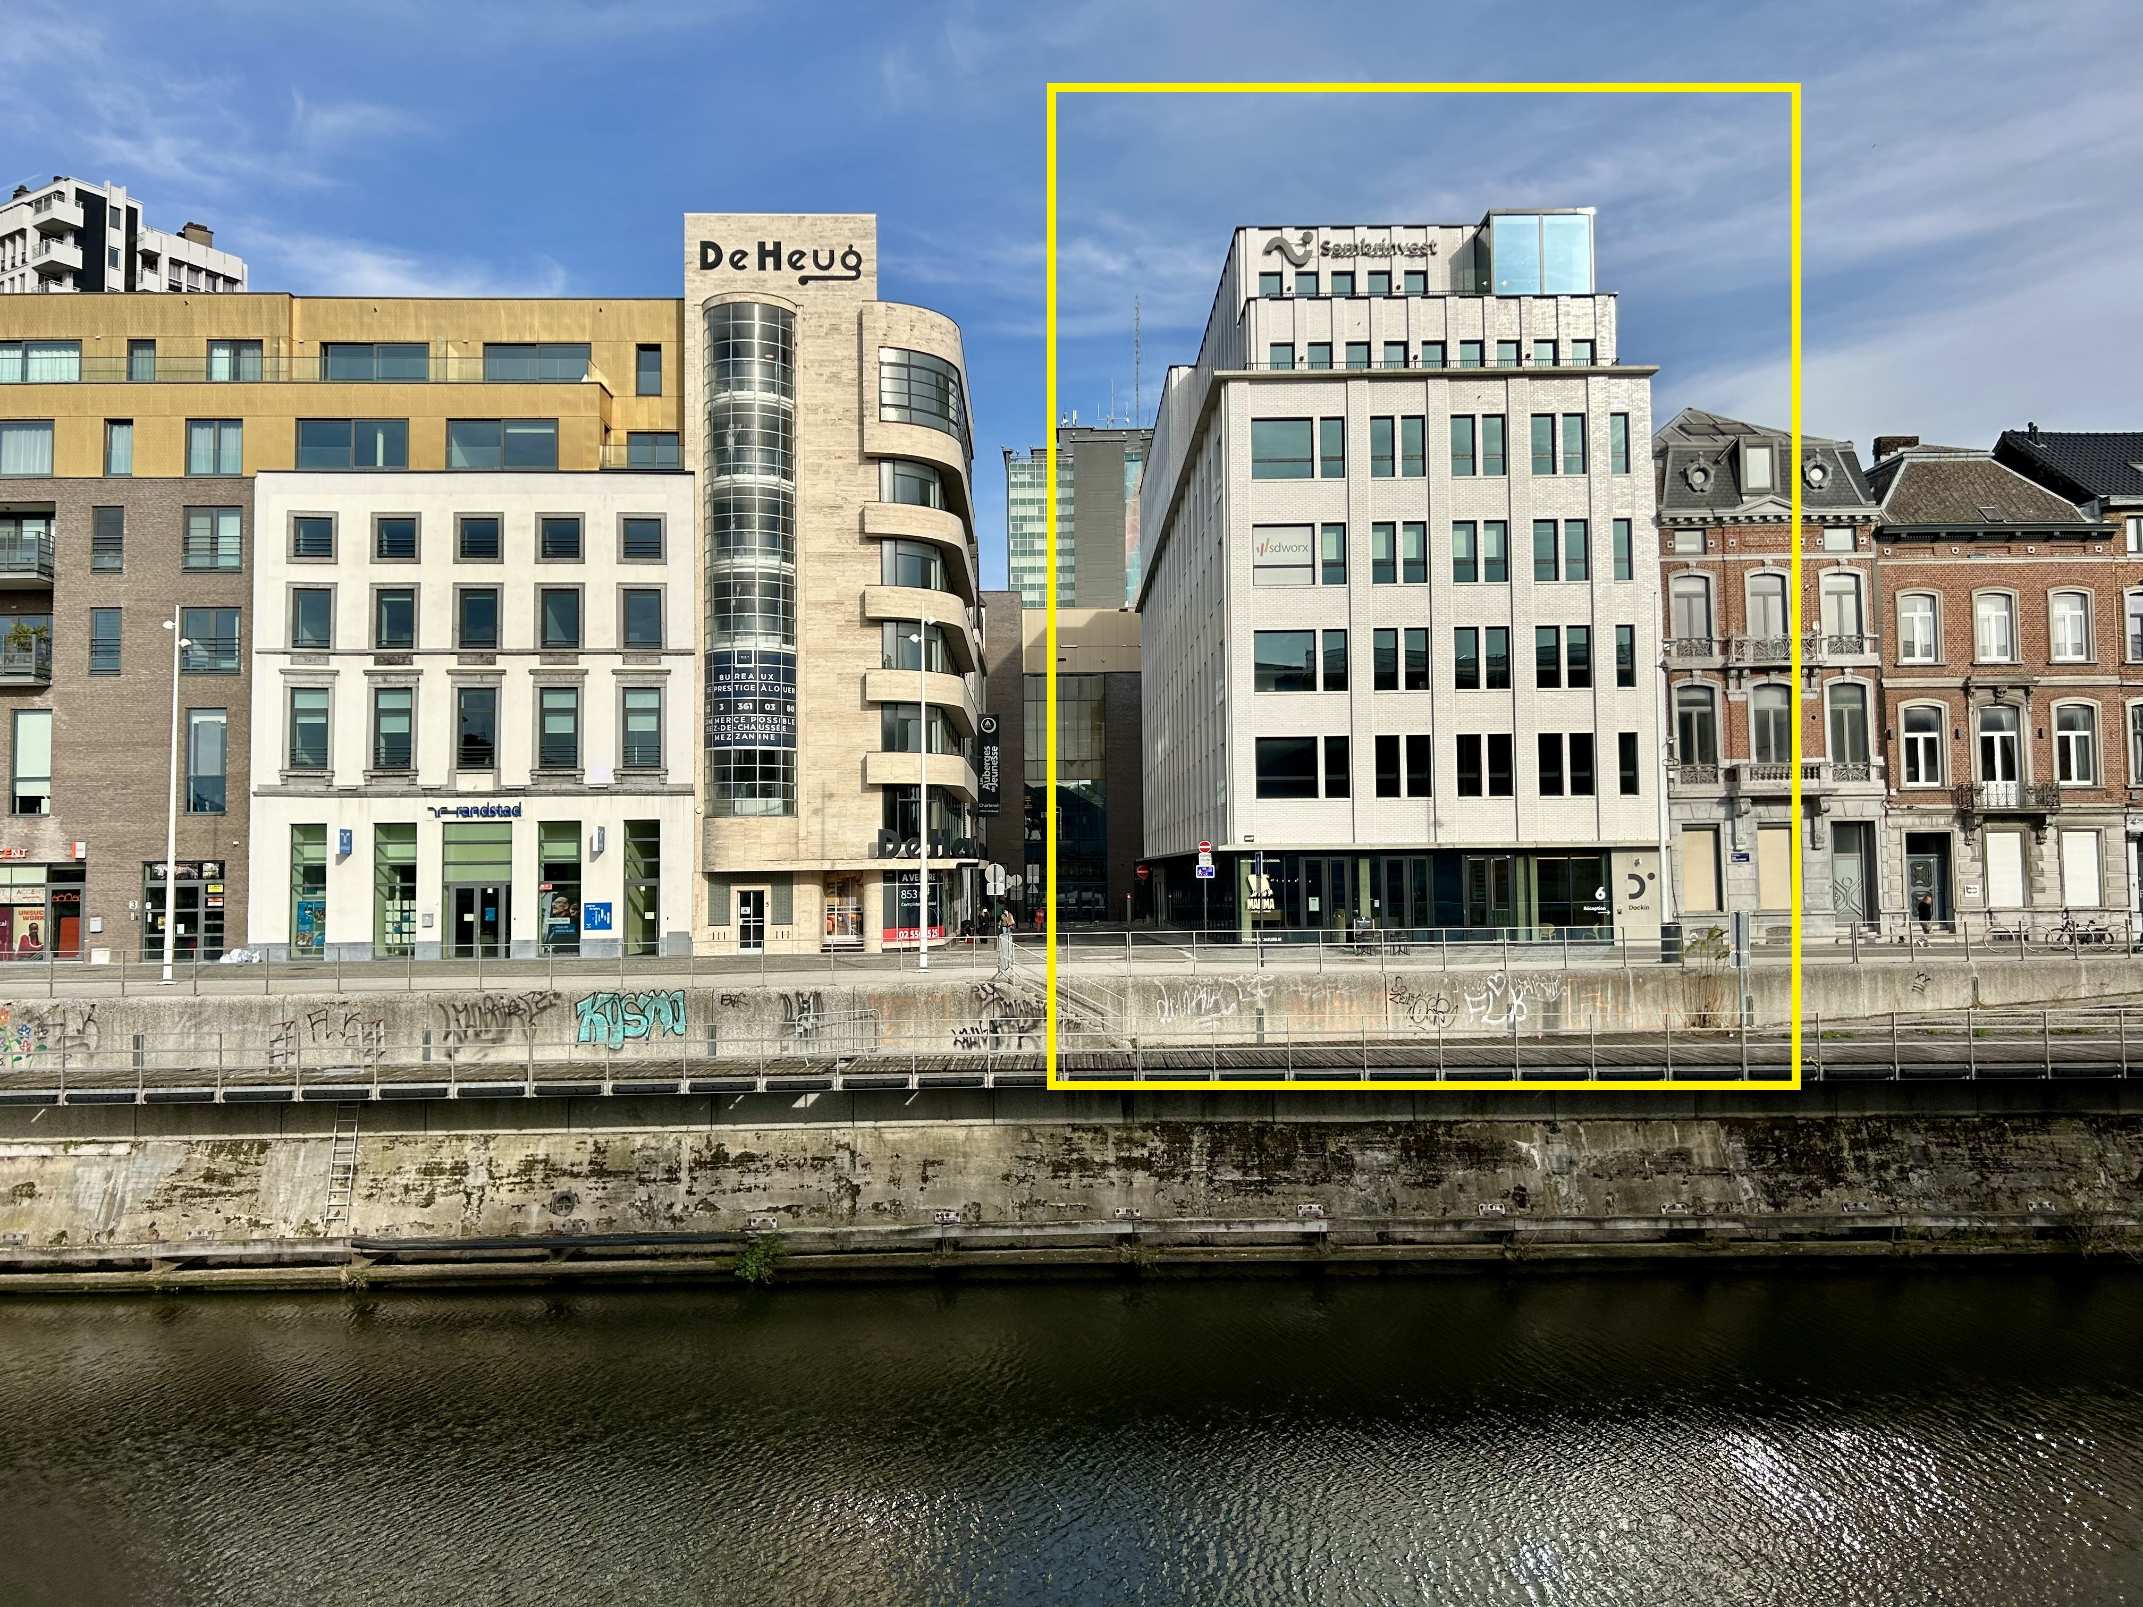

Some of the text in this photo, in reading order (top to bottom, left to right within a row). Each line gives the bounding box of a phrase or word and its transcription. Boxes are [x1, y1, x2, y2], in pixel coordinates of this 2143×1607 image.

[719, 672, 774, 681] BUREAUX
[713, 684, 756, 693] PRESTIGE
[768, 685, 795, 694] LOUER
[719, 703, 725, 711] 3
[764, 703, 776, 711] 03
[750, 716, 795, 726] POSSIBLE
[982, 745, 993, 791] Auberges
[991, 745, 999, 787] Jeunesse
[456, 801, 522, 818] randstad
[909, 872, 936, 882] VERE
[900, 889, 918, 899] 853
[1595, 886, 1606, 901] 6
[575, 989, 687, 1050] KOSMO
